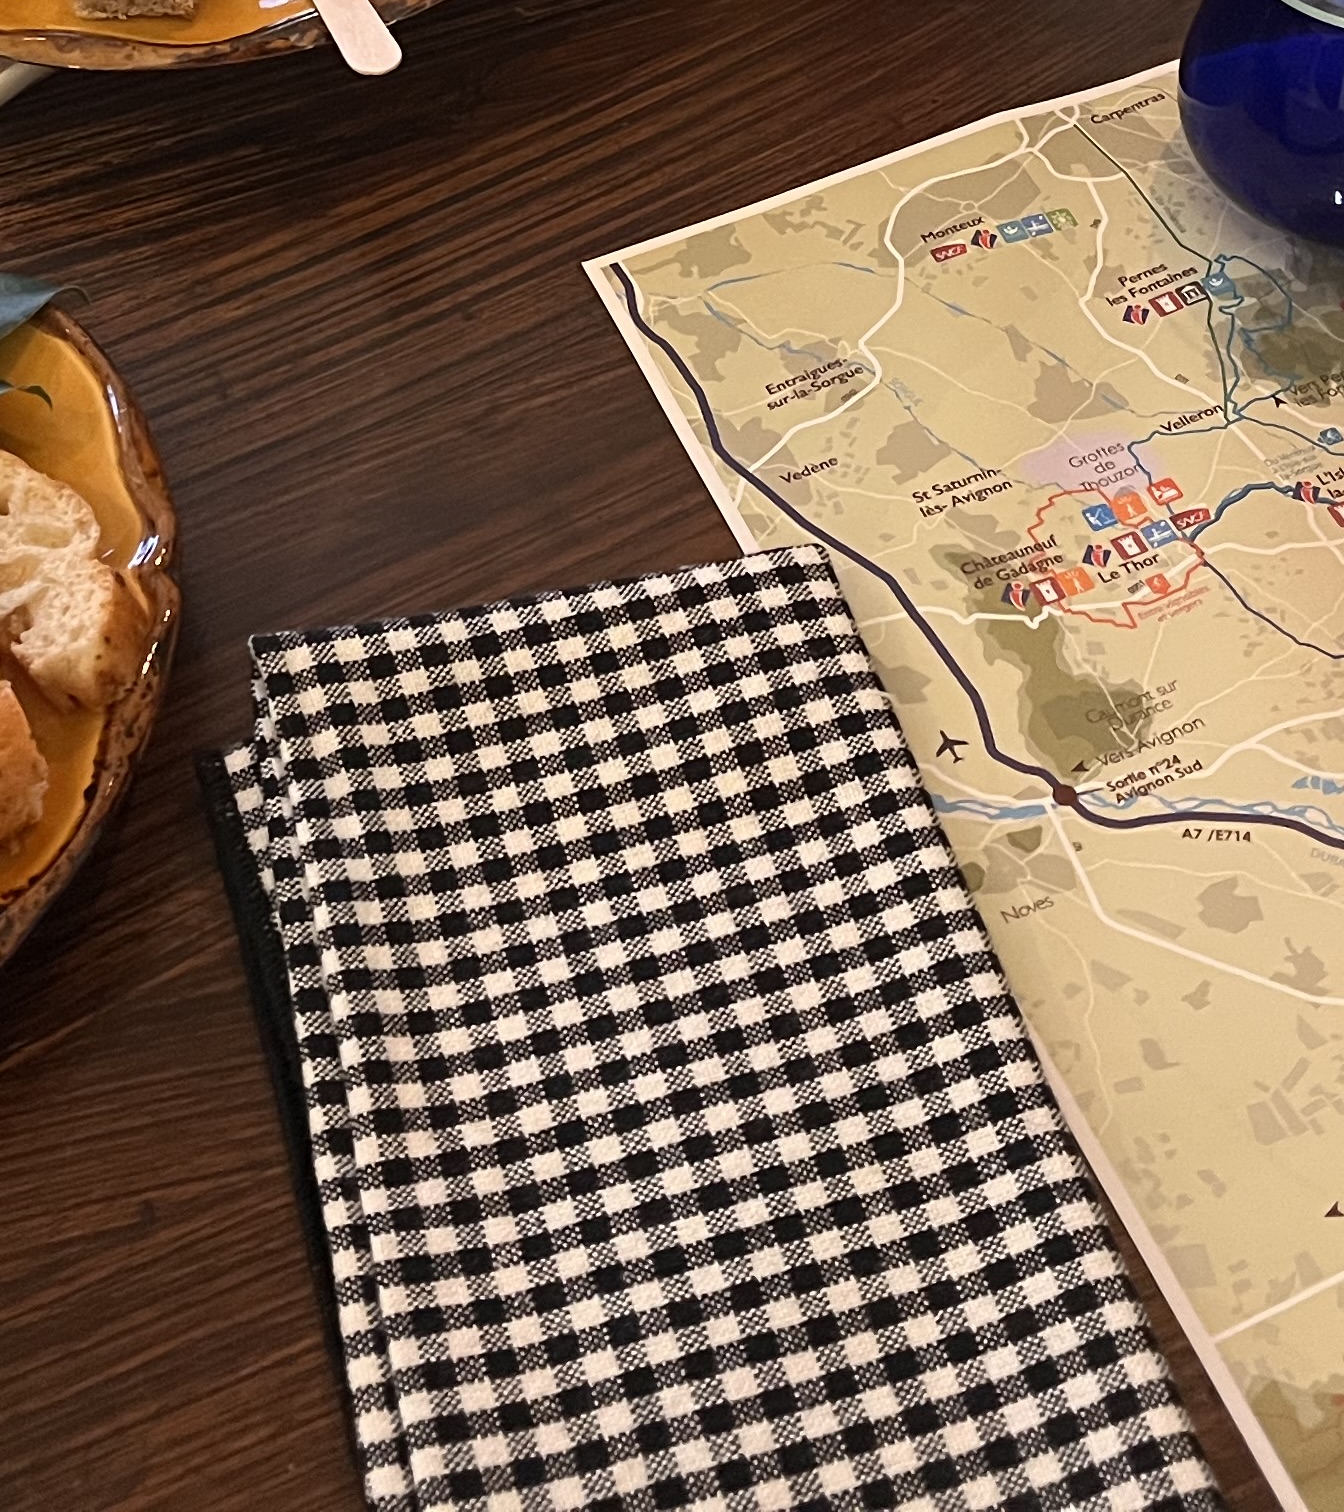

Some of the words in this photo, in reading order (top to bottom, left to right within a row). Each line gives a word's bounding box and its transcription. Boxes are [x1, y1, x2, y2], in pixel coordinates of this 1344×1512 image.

[1090, 93, 1166, 124] Carpentras
[920, 216, 985, 243] Monteux
[1105, 294, 1128, 307] les
[1128, 267, 1198, 298] Fontaines
[1117, 263, 1168, 287] Pernes
[765, 358, 848, 395] Entraigues-
[767, 366, 864, 411] sur-la-Sorgue
[1160, 404, 1224, 432] Velleron
[1068, 442, 1125, 468] Grottes
[1094, 460, 1116, 474] de
[778, 456, 838, 484] Vedène
[912, 490, 931, 504] St
[931, 468, 1002, 496] Saturnin-
[951, 480, 1013, 507] Avignon
[960, 533, 1058, 575] Châteauneuf
[974, 576, 994, 590] de
[996, 554, 1064, 581] Gadagne
[1097, 569, 1121, 584] Le
[1118, 553, 1160, 574] Thor
[1156, 679, 1177, 696] sur
[1096, 749, 1134, 766] Vers
[1137, 717, 1206, 754] Avignon
[1106, 770, 1147, 792] Sortie
[1116, 774, 1175, 804] Avignon
[1174, 759, 1203, 779] Sud
[1182, 828, 1203, 840] A7
[1000, 896, 1054, 924] Noves
